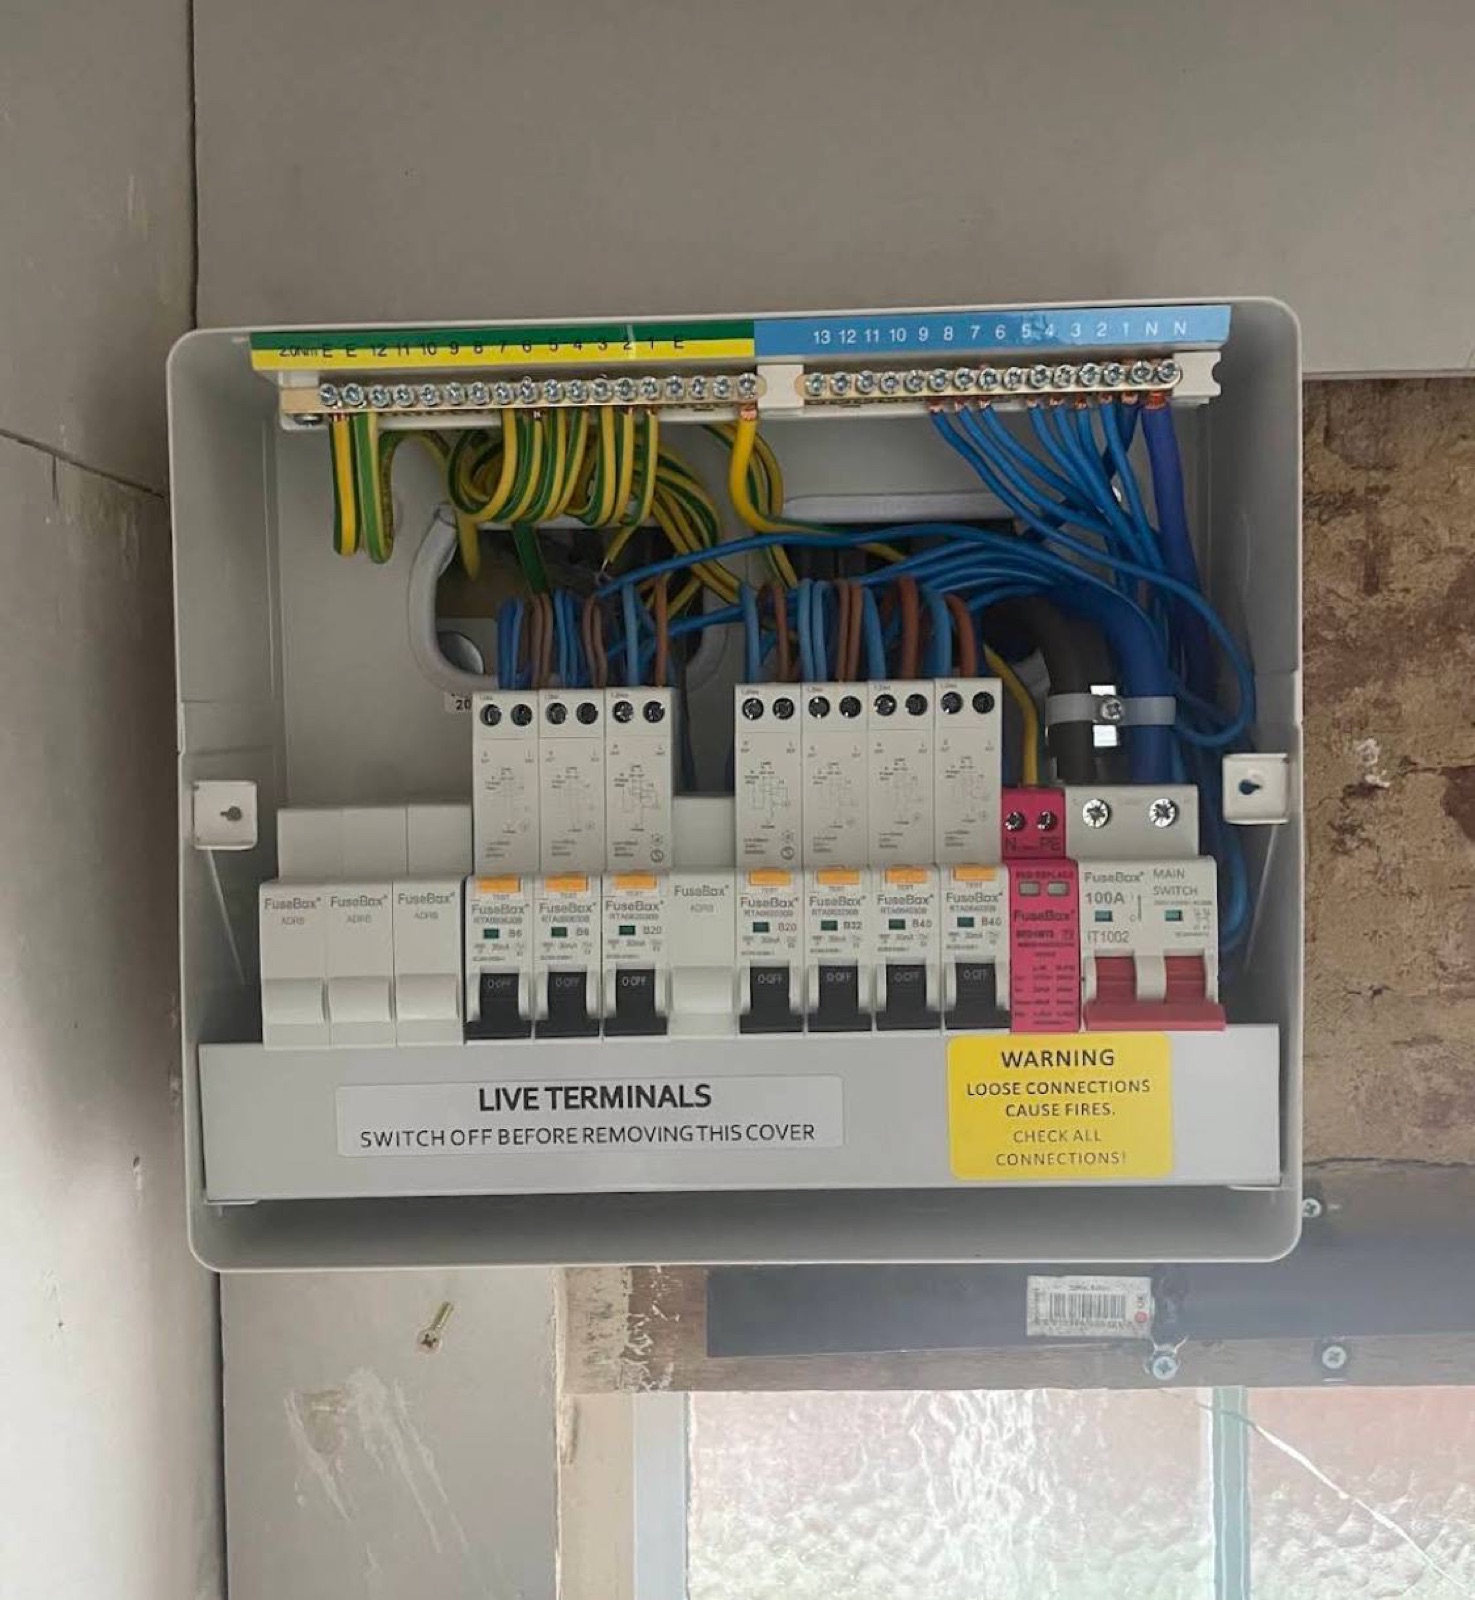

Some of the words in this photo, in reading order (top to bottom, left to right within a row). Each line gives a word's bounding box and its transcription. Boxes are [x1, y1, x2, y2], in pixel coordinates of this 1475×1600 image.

[814, 330, 831, 345] 13
[839, 329, 857, 344] 12
[865, 328, 880, 344] 11
[889, 328, 907, 343] 10
[918, 327, 929, 342] 9
[943, 326, 954, 342] 8
[970, 326, 981, 341] 7
[995, 325, 1006, 340] 6
[1022, 324, 1032, 339] 5
[1044, 323, 1055, 338] 4
[1071, 323, 1081, 338] 3
[1096, 322, 1107, 338] 2
[1146, 322, 1158, 336] N
[1174, 321, 1187, 335] N
[323, 344, 333, 358] E
[346, 343, 357, 358] E
[371, 343, 388, 357] 12
[397, 342, 410, 357] 11
[421, 342, 437, 356] 10
[573, 338, 582, 352] 4
[623, 337, 633, 351] 2
[674, 336, 684, 350] E
[1084, 871, 1140, 882] FuseBox
[1153, 868, 1185, 879] MAIN
[674, 885, 725, 897] FuseBox
[1153, 885, 1198, 896] SWITCH
[330, 895, 384, 908] FuseBox
[398, 892, 451, 905] FuseBox
[740, 897, 795, 908] FuseBox
[809, 896, 861, 907] FuseBox
[877, 894, 930, 905] FuseBox
[946, 892, 999, 903] FuseBox
[1085, 892, 1125, 904] 100A
[264, 898, 318, 910] FuseBox
[471, 903, 525, 915] FuseBox
[539, 902, 593, 914] FuseBox
[605, 900, 660, 912] FuseBox
[981, 917, 1002, 926] B40
[1014, 910, 1070, 922] FuseBox
[778, 923, 797, 932] B20
[843, 921, 862, 930] B32
[912, 919, 932, 928] B40
[643, 926, 662, 935] B20
[1087, 930, 1129, 943] IT1002
[1001, 1049, 1114, 1067] WARNING
[967, 1082, 1021, 1096] LOOSE
[1026, 1079, 1150, 1095] CONNECTIONS
[478, 1087, 540, 1112] LIVE
[545, 1084, 712, 1110] TERMINALS
[1006, 1103, 1059, 1117] CAUSE
[1065, 1102, 1115, 1116] FIRES.
[361, 1129, 445, 1148] SWITCH
[451, 1128, 492, 1147] OFF
[499, 1128, 578, 1146] BEFORE
[582, 1126, 693, 1144] REMOVING
[698, 1125, 741, 1142] THIS
[745, 1124, 814, 1141] COVER
[1013, 1130, 1069, 1143] CHECK
[1073, 1129, 1101, 1142] ALL
[996, 1152, 1126, 1166] CONNECTIONS!
